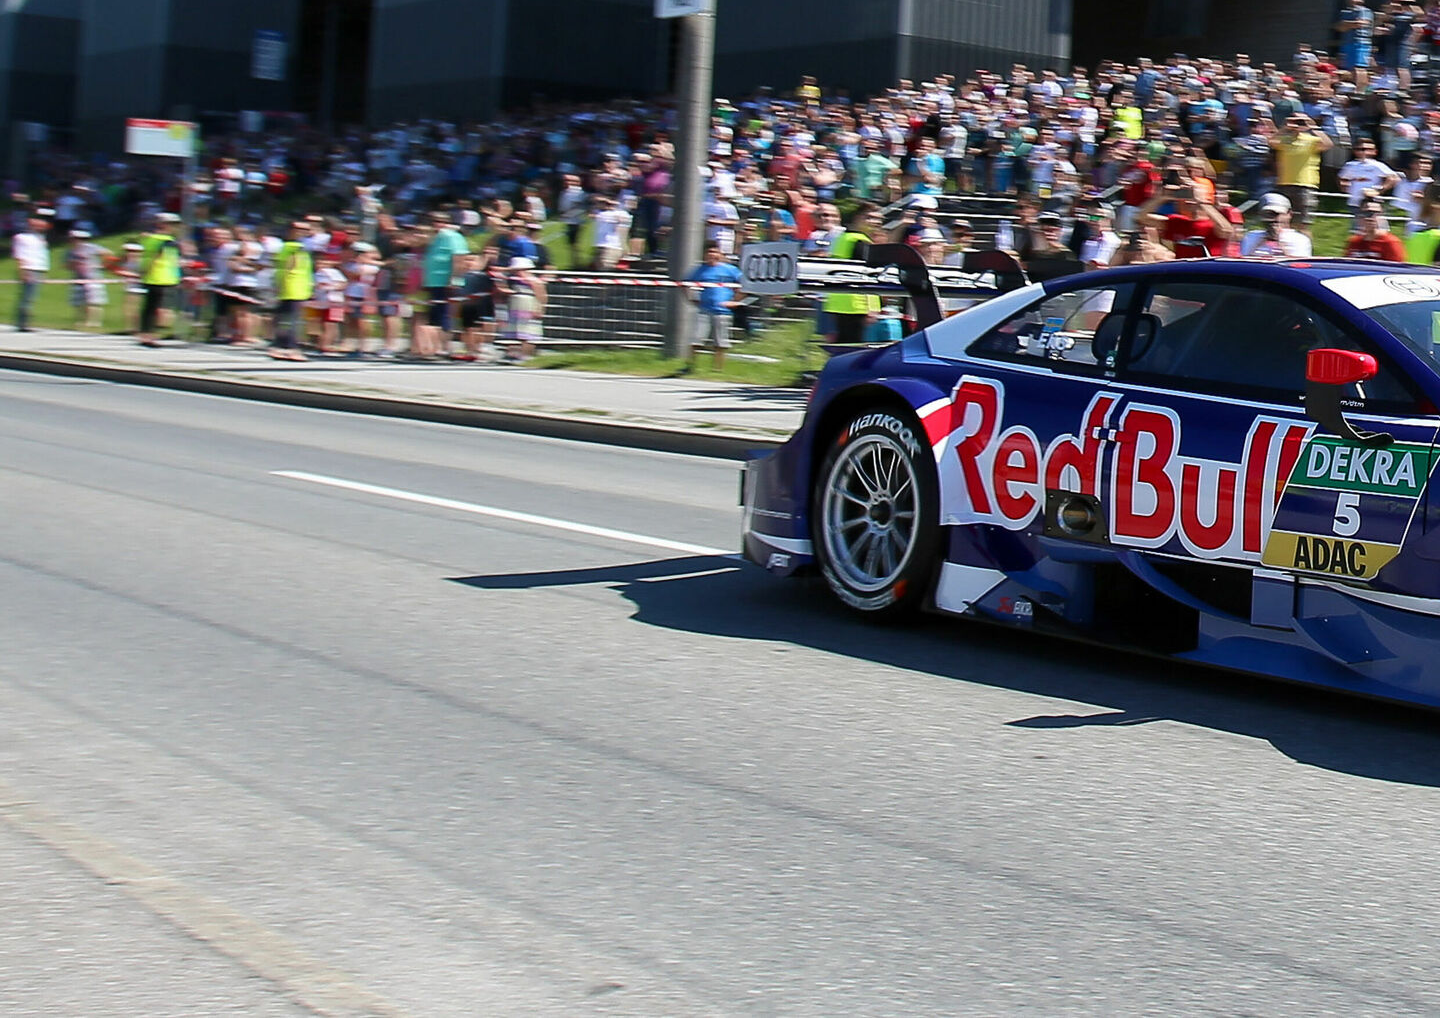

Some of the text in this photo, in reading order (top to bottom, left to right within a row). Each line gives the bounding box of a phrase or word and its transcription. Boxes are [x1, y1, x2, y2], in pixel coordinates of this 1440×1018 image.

[950, 379, 1116, 523] Red
[1305, 443, 1417, 489] DEKRA
[1331, 492, 1361, 537] 5
[1293, 535, 1367, 577] ADAC
